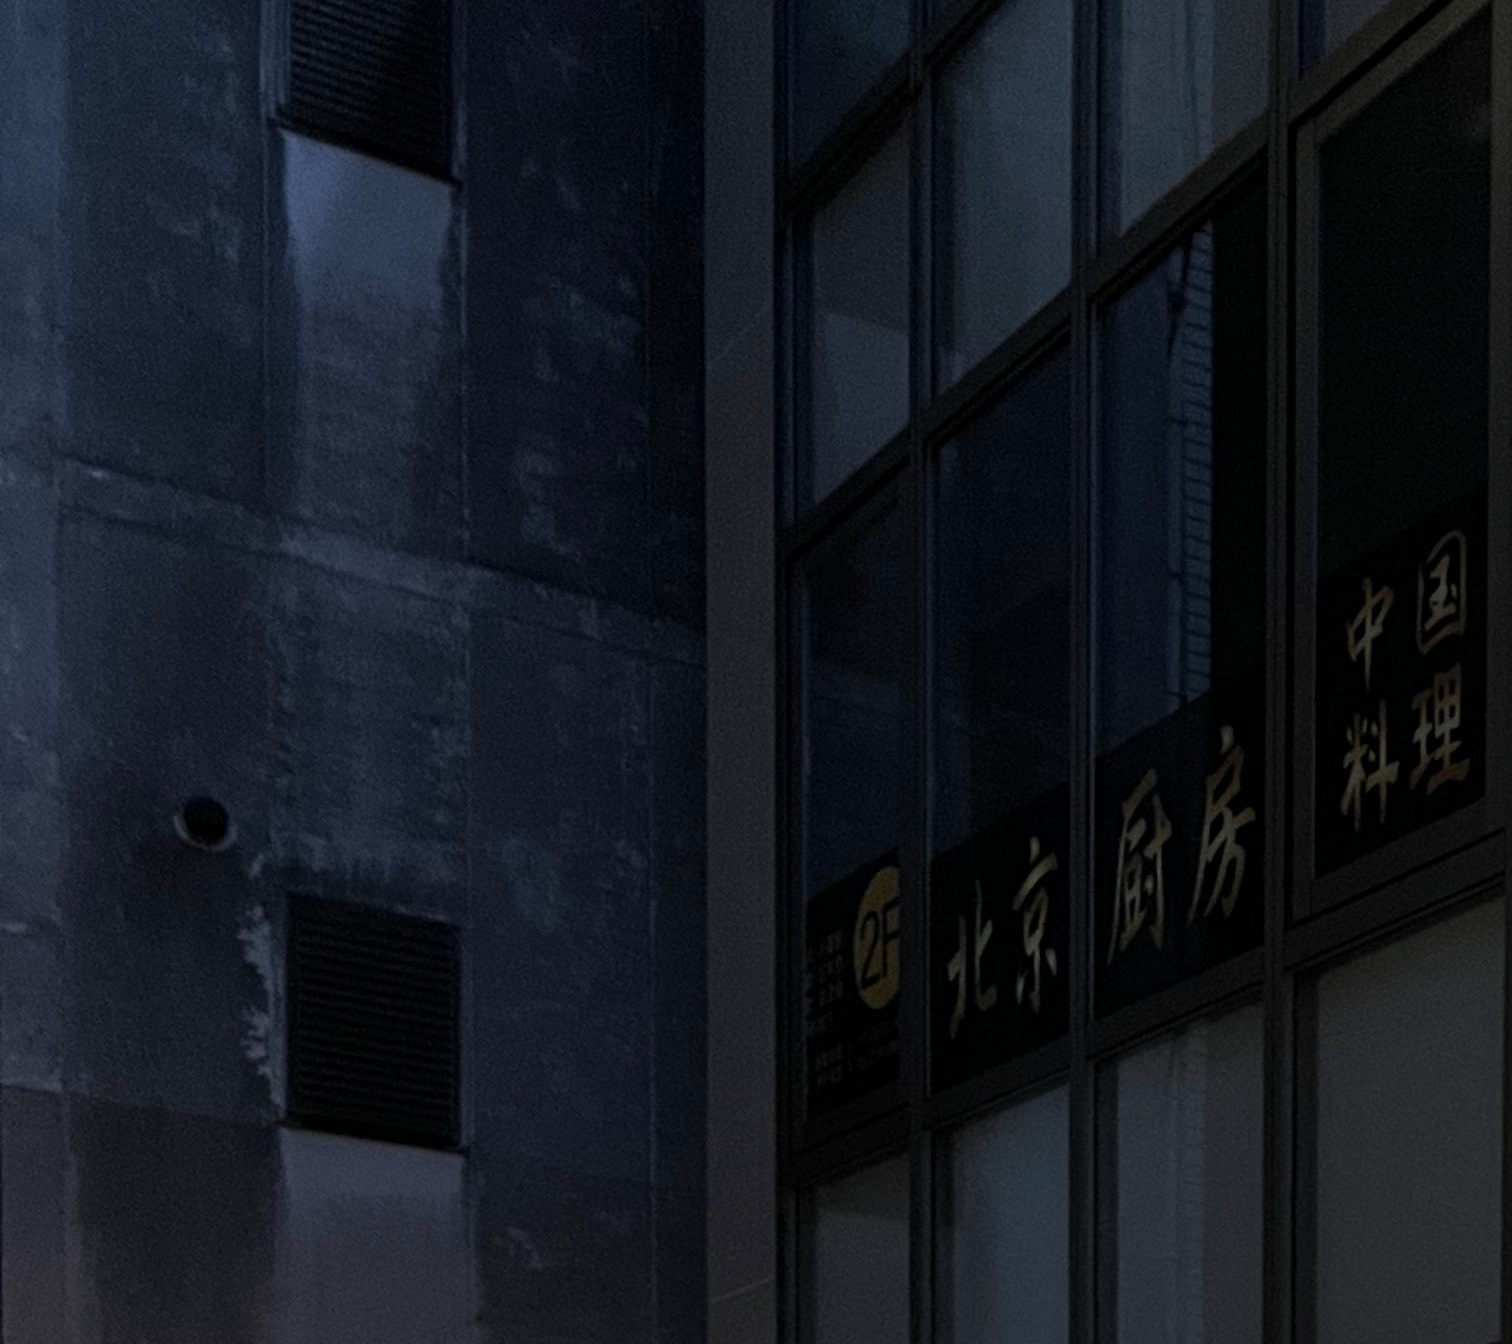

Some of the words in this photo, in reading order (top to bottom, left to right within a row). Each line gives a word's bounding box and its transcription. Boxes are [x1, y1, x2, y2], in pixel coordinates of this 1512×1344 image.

[1346, 529, 1467, 689] 中国
[1340, 663, 1470, 832] 料理
[946, 725, 1256, 1040] 北京厨房
